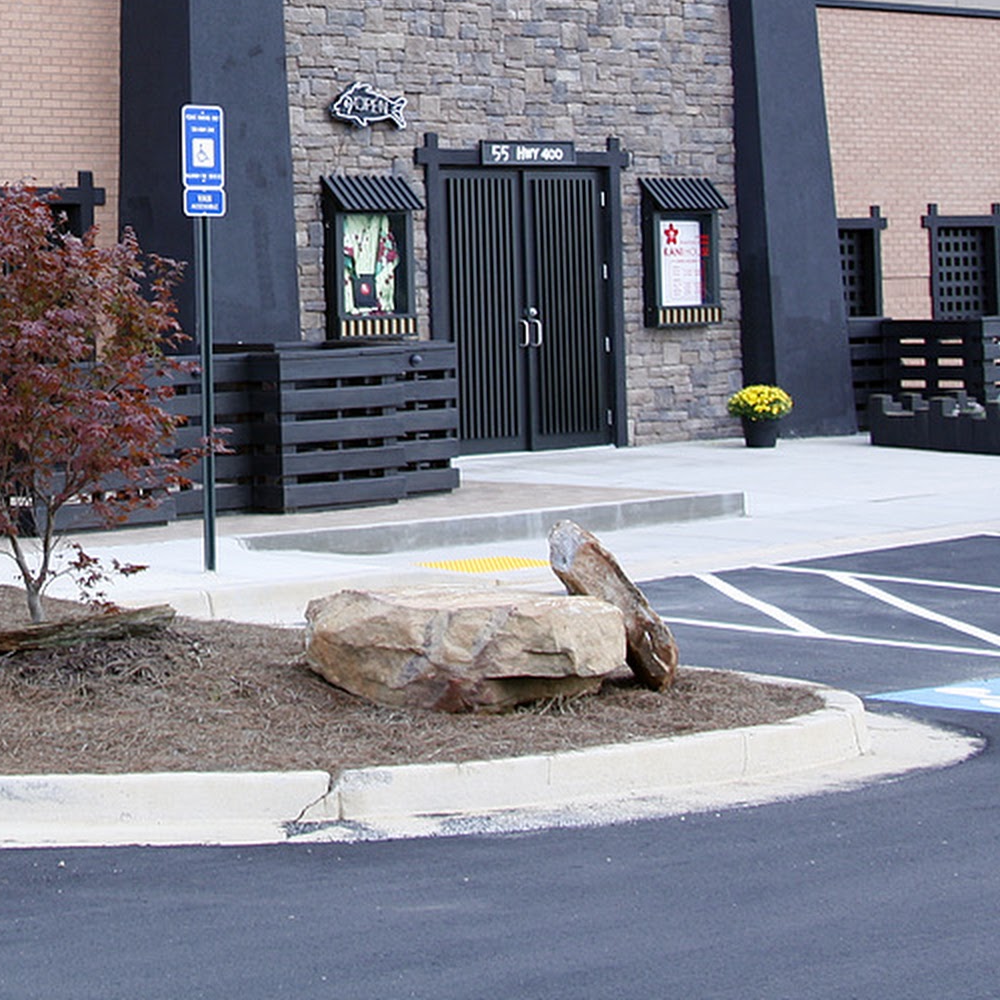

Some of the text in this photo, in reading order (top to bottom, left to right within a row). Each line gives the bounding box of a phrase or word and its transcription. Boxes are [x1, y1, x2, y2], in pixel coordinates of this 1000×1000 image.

[354, 95, 389, 115] OPEN
[491, 144, 510, 162] 55
[540, 147, 564, 161] 400
